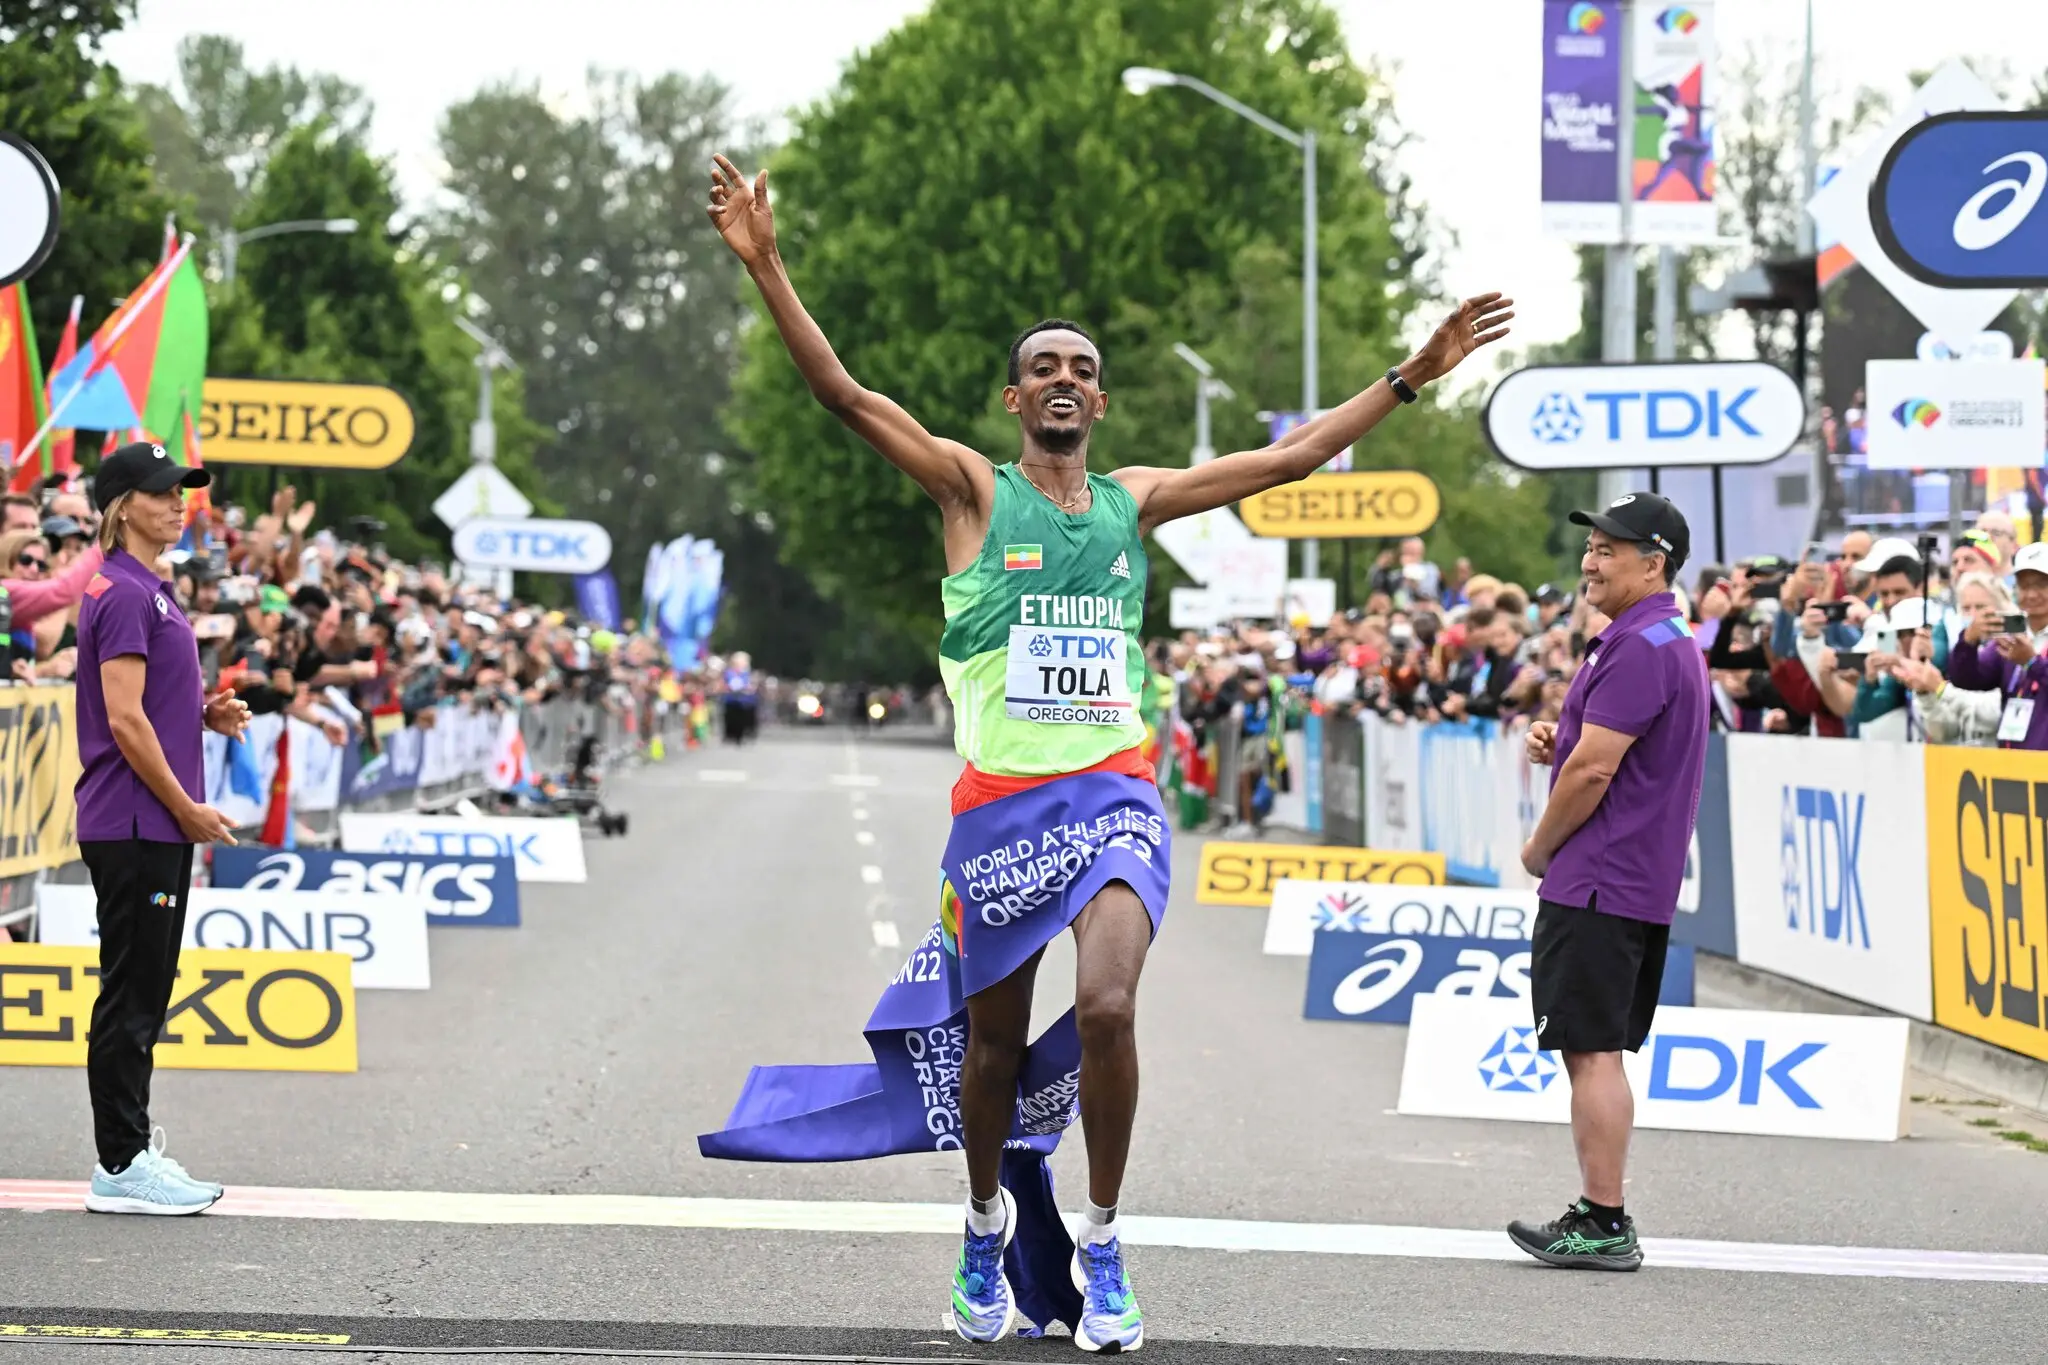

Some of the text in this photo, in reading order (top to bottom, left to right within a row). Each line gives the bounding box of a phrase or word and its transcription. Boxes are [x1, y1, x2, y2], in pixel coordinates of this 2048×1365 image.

[200, 400, 389, 447] SEIKO
[1585, 387, 1762, 440] TDK
[1262, 486, 1421, 522] SEIKO
[505, 530, 589, 560] TDK
[1020, 594, 1124, 629] ETHIOPIA
[1052, 635, 1116, 660] TDK
[1038, 666, 1111, 697] TOLA
[1028, 706, 1120, 723] OREGON22
[420, 831, 543, 865] TDK
[960, 807, 1162, 880] WORLD ATHLETICS
[318, 859, 496, 916] asics
[1796, 787, 1870, 950] TDK
[195, 909, 375, 962] QNB
[1389, 902, 1527, 939] QNB
[0, 964, 343, 1049] EKO
[1642, 1034, 1830, 1109] DK
